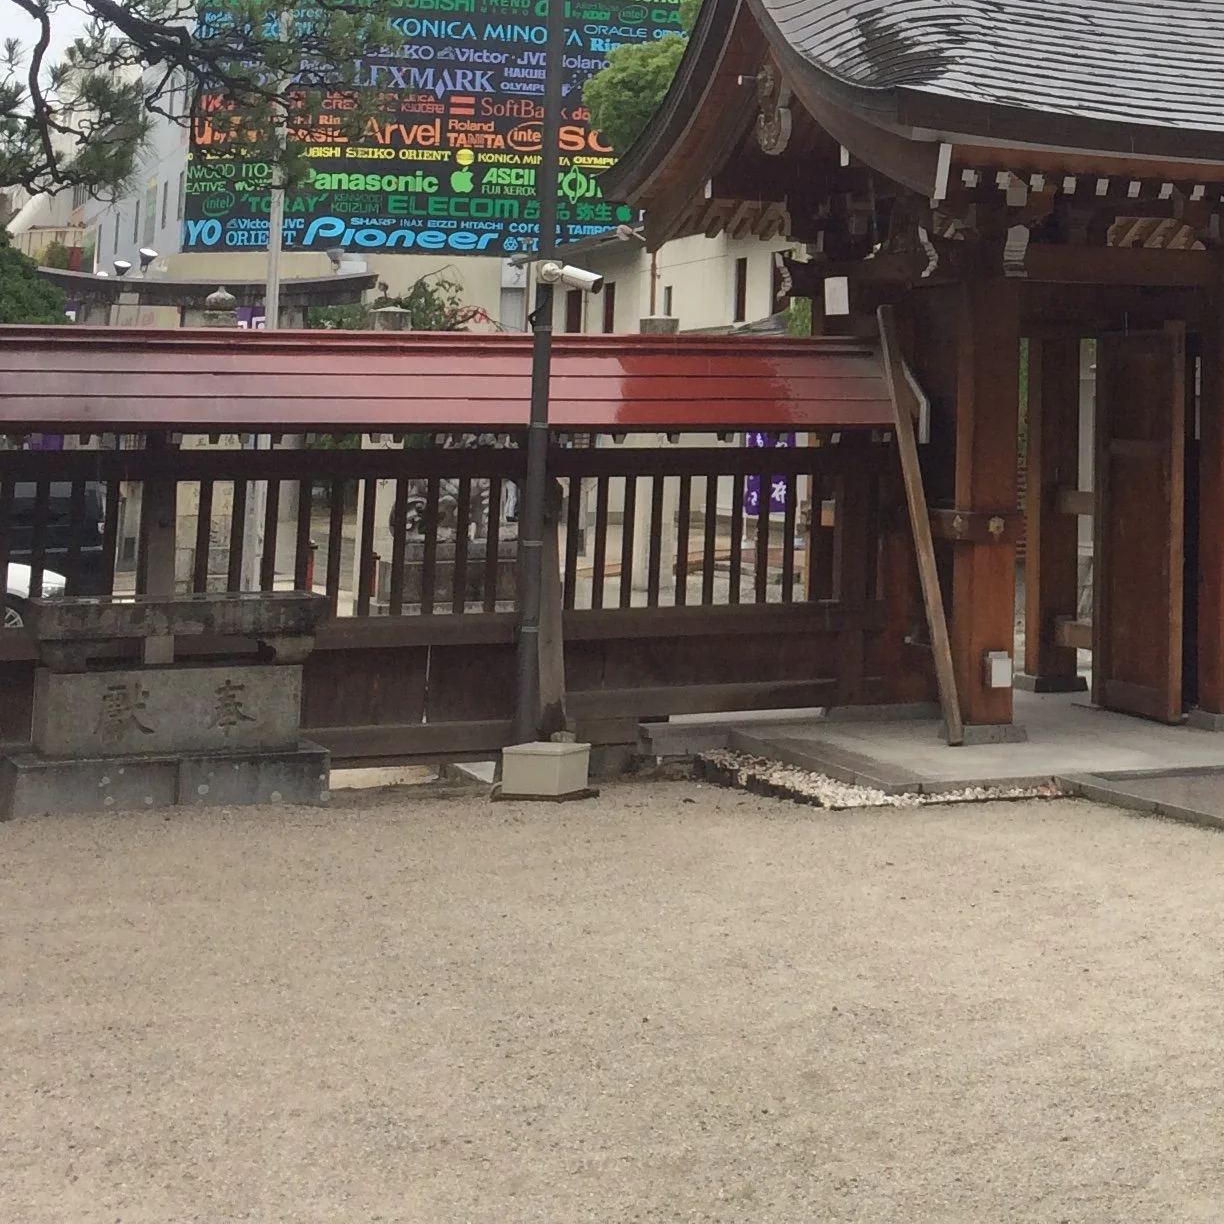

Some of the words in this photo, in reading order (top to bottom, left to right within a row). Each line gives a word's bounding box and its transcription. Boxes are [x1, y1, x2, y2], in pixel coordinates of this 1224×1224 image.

[480, 6, 530, 16] MICRO
[483, 22, 583, 47] MINOA
[583, 24, 648, 38] ORACLE
[454, 47, 510, 64] Victor
[363, 116, 441, 146] Arvel
[448, 118, 495, 131] Roland
[446, 132, 505, 149] TANITA
[345, 147, 395, 160] SEIKO
[399, 148, 452, 162] ORIENT
[477, 152, 521, 164] KONICA
[482, 167, 536, 186] ASCII
[482, 184, 500, 194] FUJI
[503, 185, 537, 197] XEROX
[237, 218, 270, 229] Victo
[350, 217, 396, 226] SHARP
[400, 218, 423, 227] INAX
[427, 219, 457, 228] EIZO
[460, 220, 504, 230] HITACHI
[226, 230, 297, 246] ORIET
[302, 216, 499, 250] Pioneer
